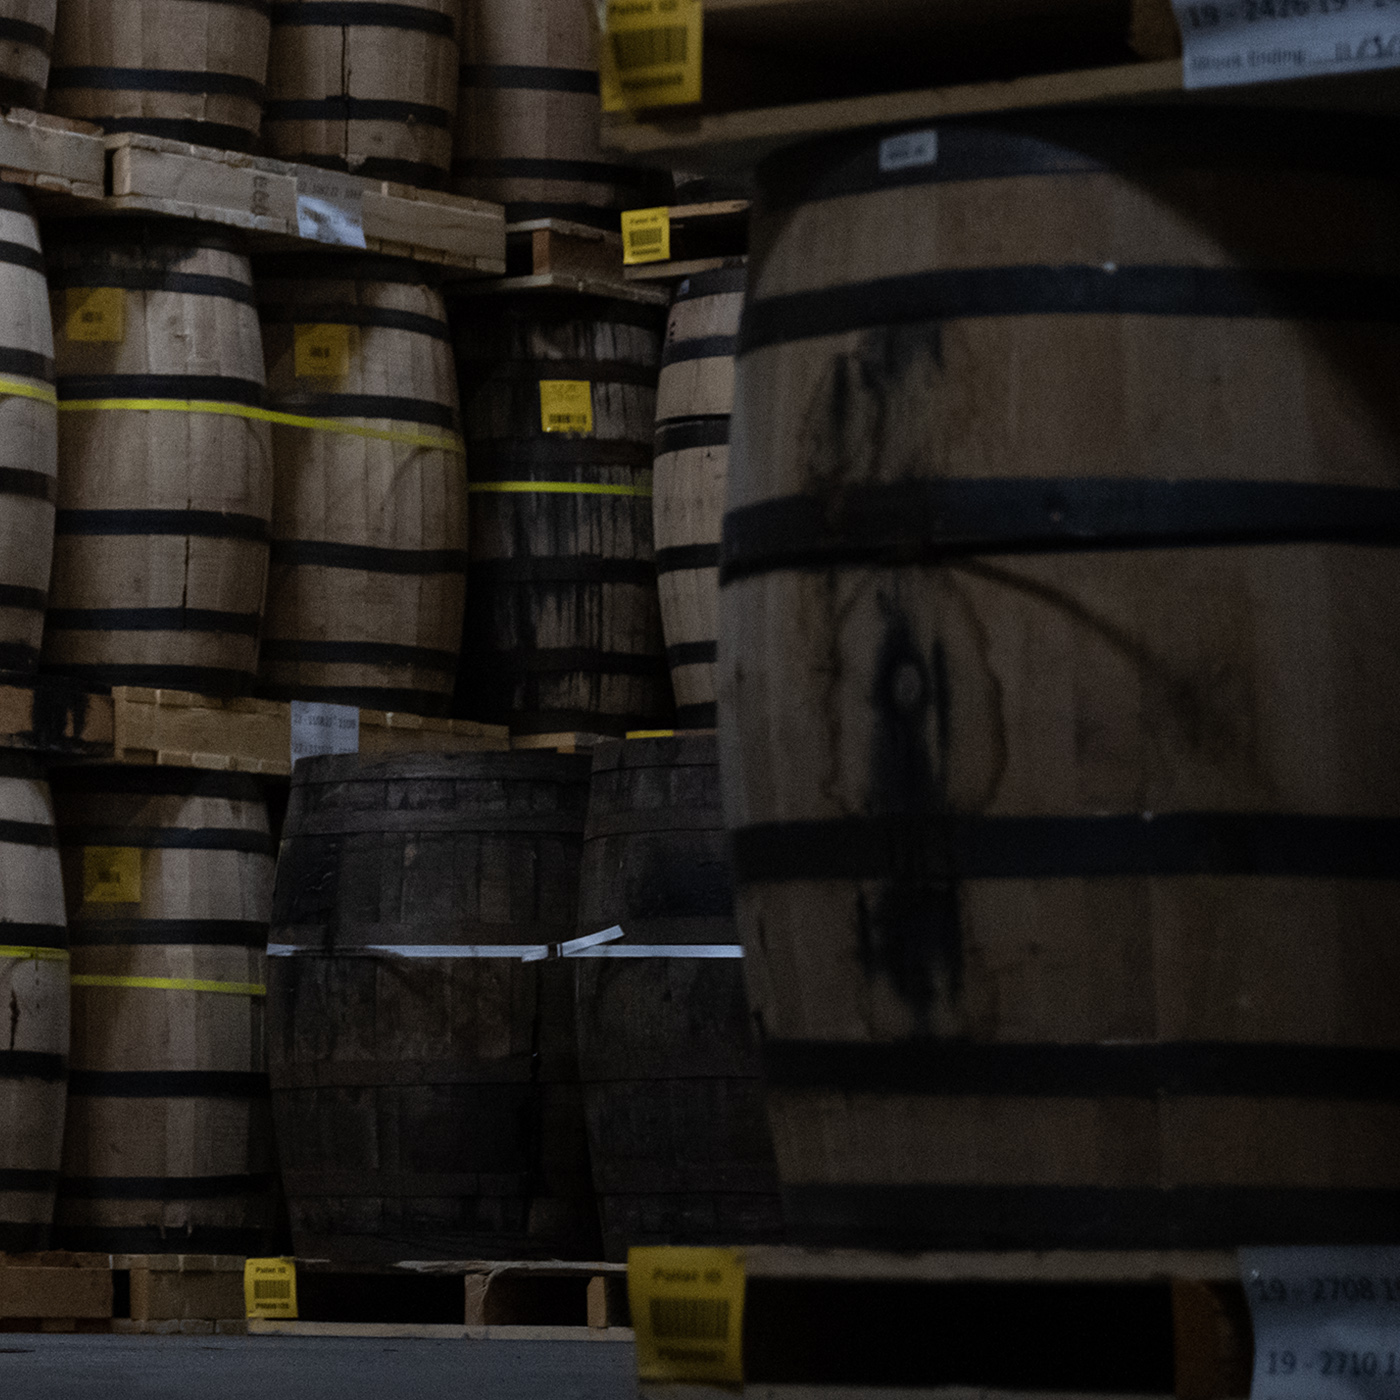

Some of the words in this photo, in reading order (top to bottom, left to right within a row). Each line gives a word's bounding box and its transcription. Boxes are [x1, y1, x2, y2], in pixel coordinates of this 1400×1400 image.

[1189, 4, 1219, 29] 19
[1382, 1277, 1400, 1301] 1
[1268, 1350, 1297, 1375] 19
[1319, 1350, 1377, 1378] 2710
